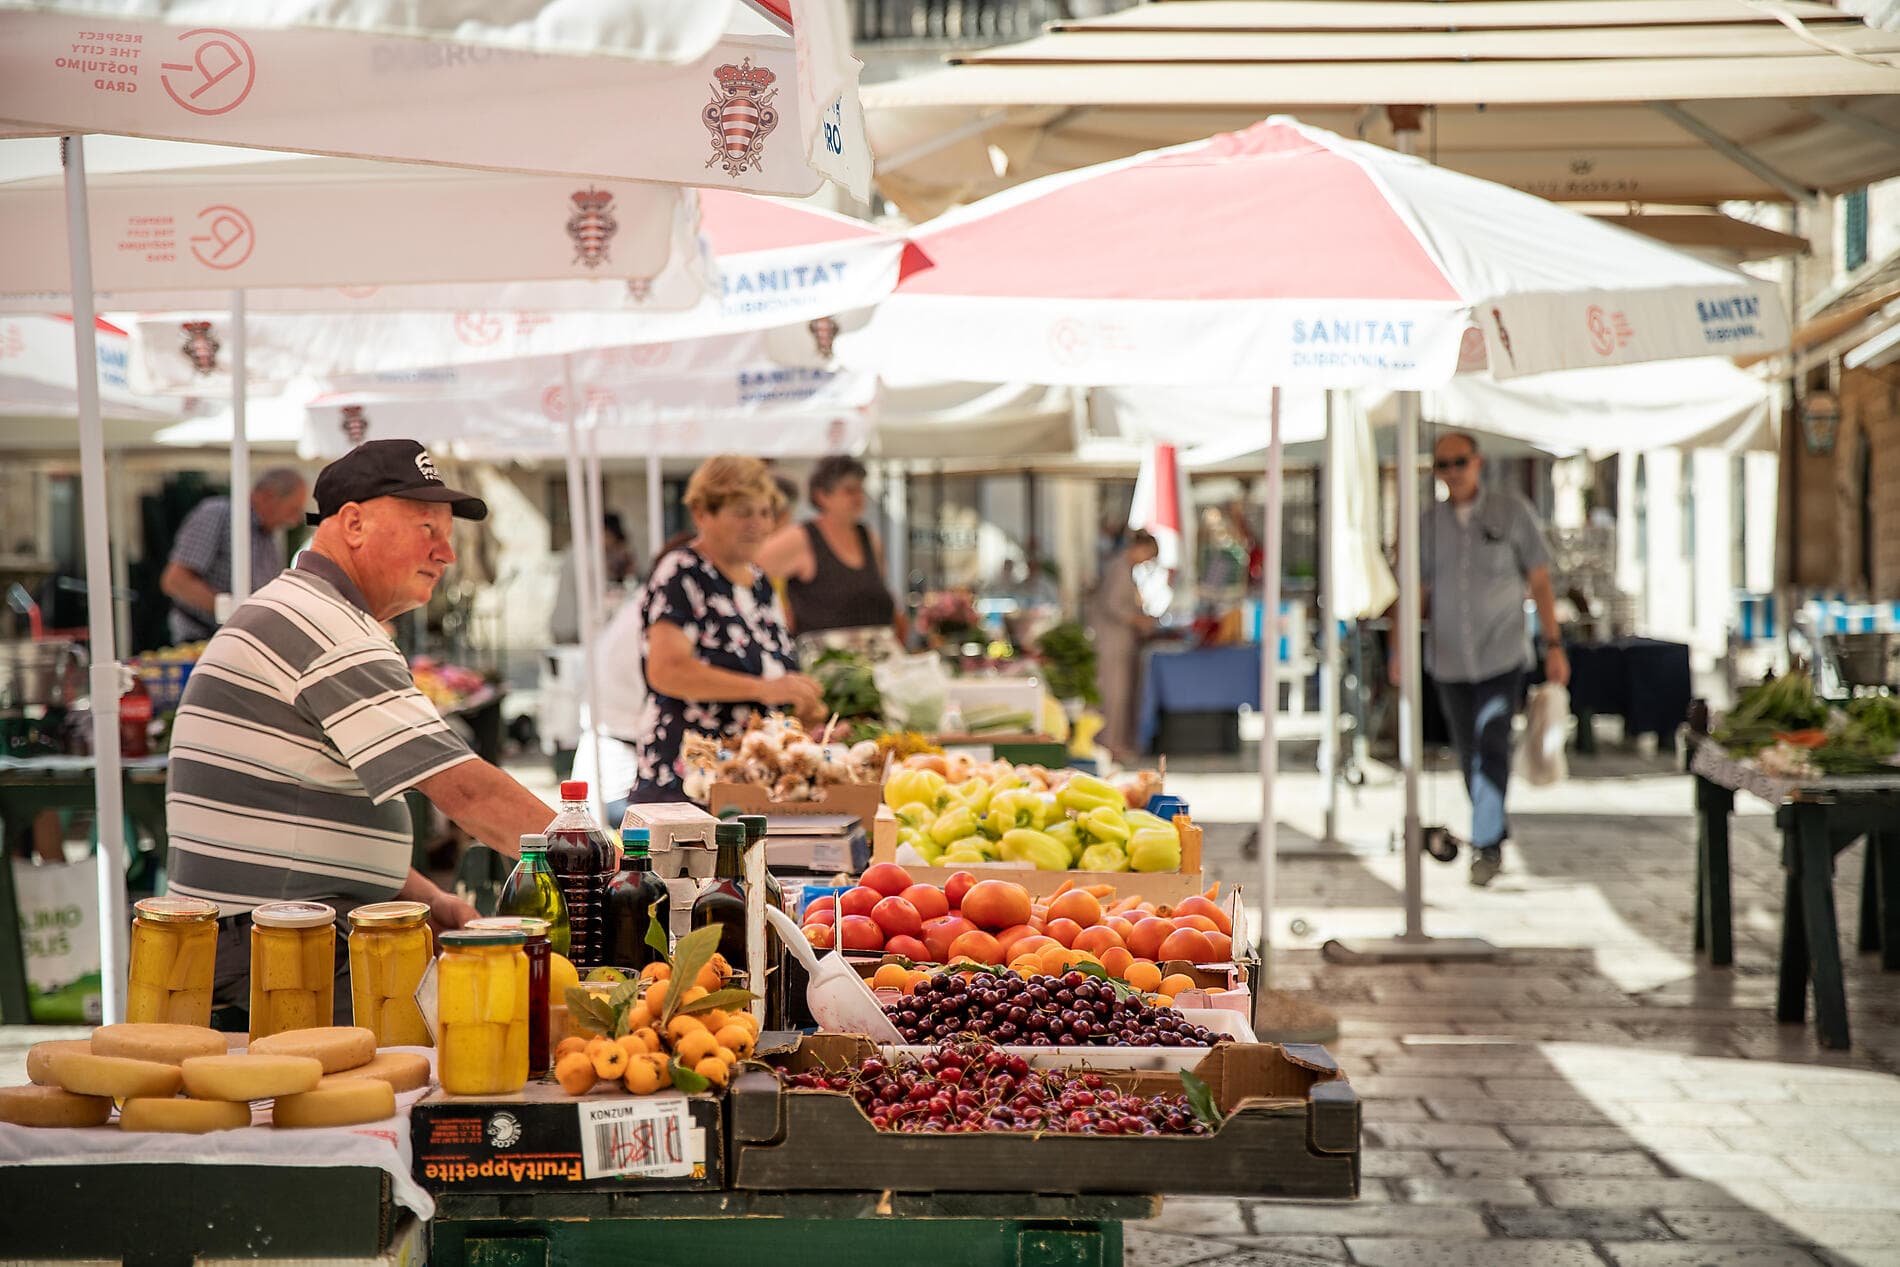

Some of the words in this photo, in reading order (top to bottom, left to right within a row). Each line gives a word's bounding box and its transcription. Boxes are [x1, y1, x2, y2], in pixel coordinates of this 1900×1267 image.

[1293, 319, 1413, 344] SANITAT
[590, 1107, 633, 1120] KONZUM
[425, 1160, 583, 1182] FruitAppetite
